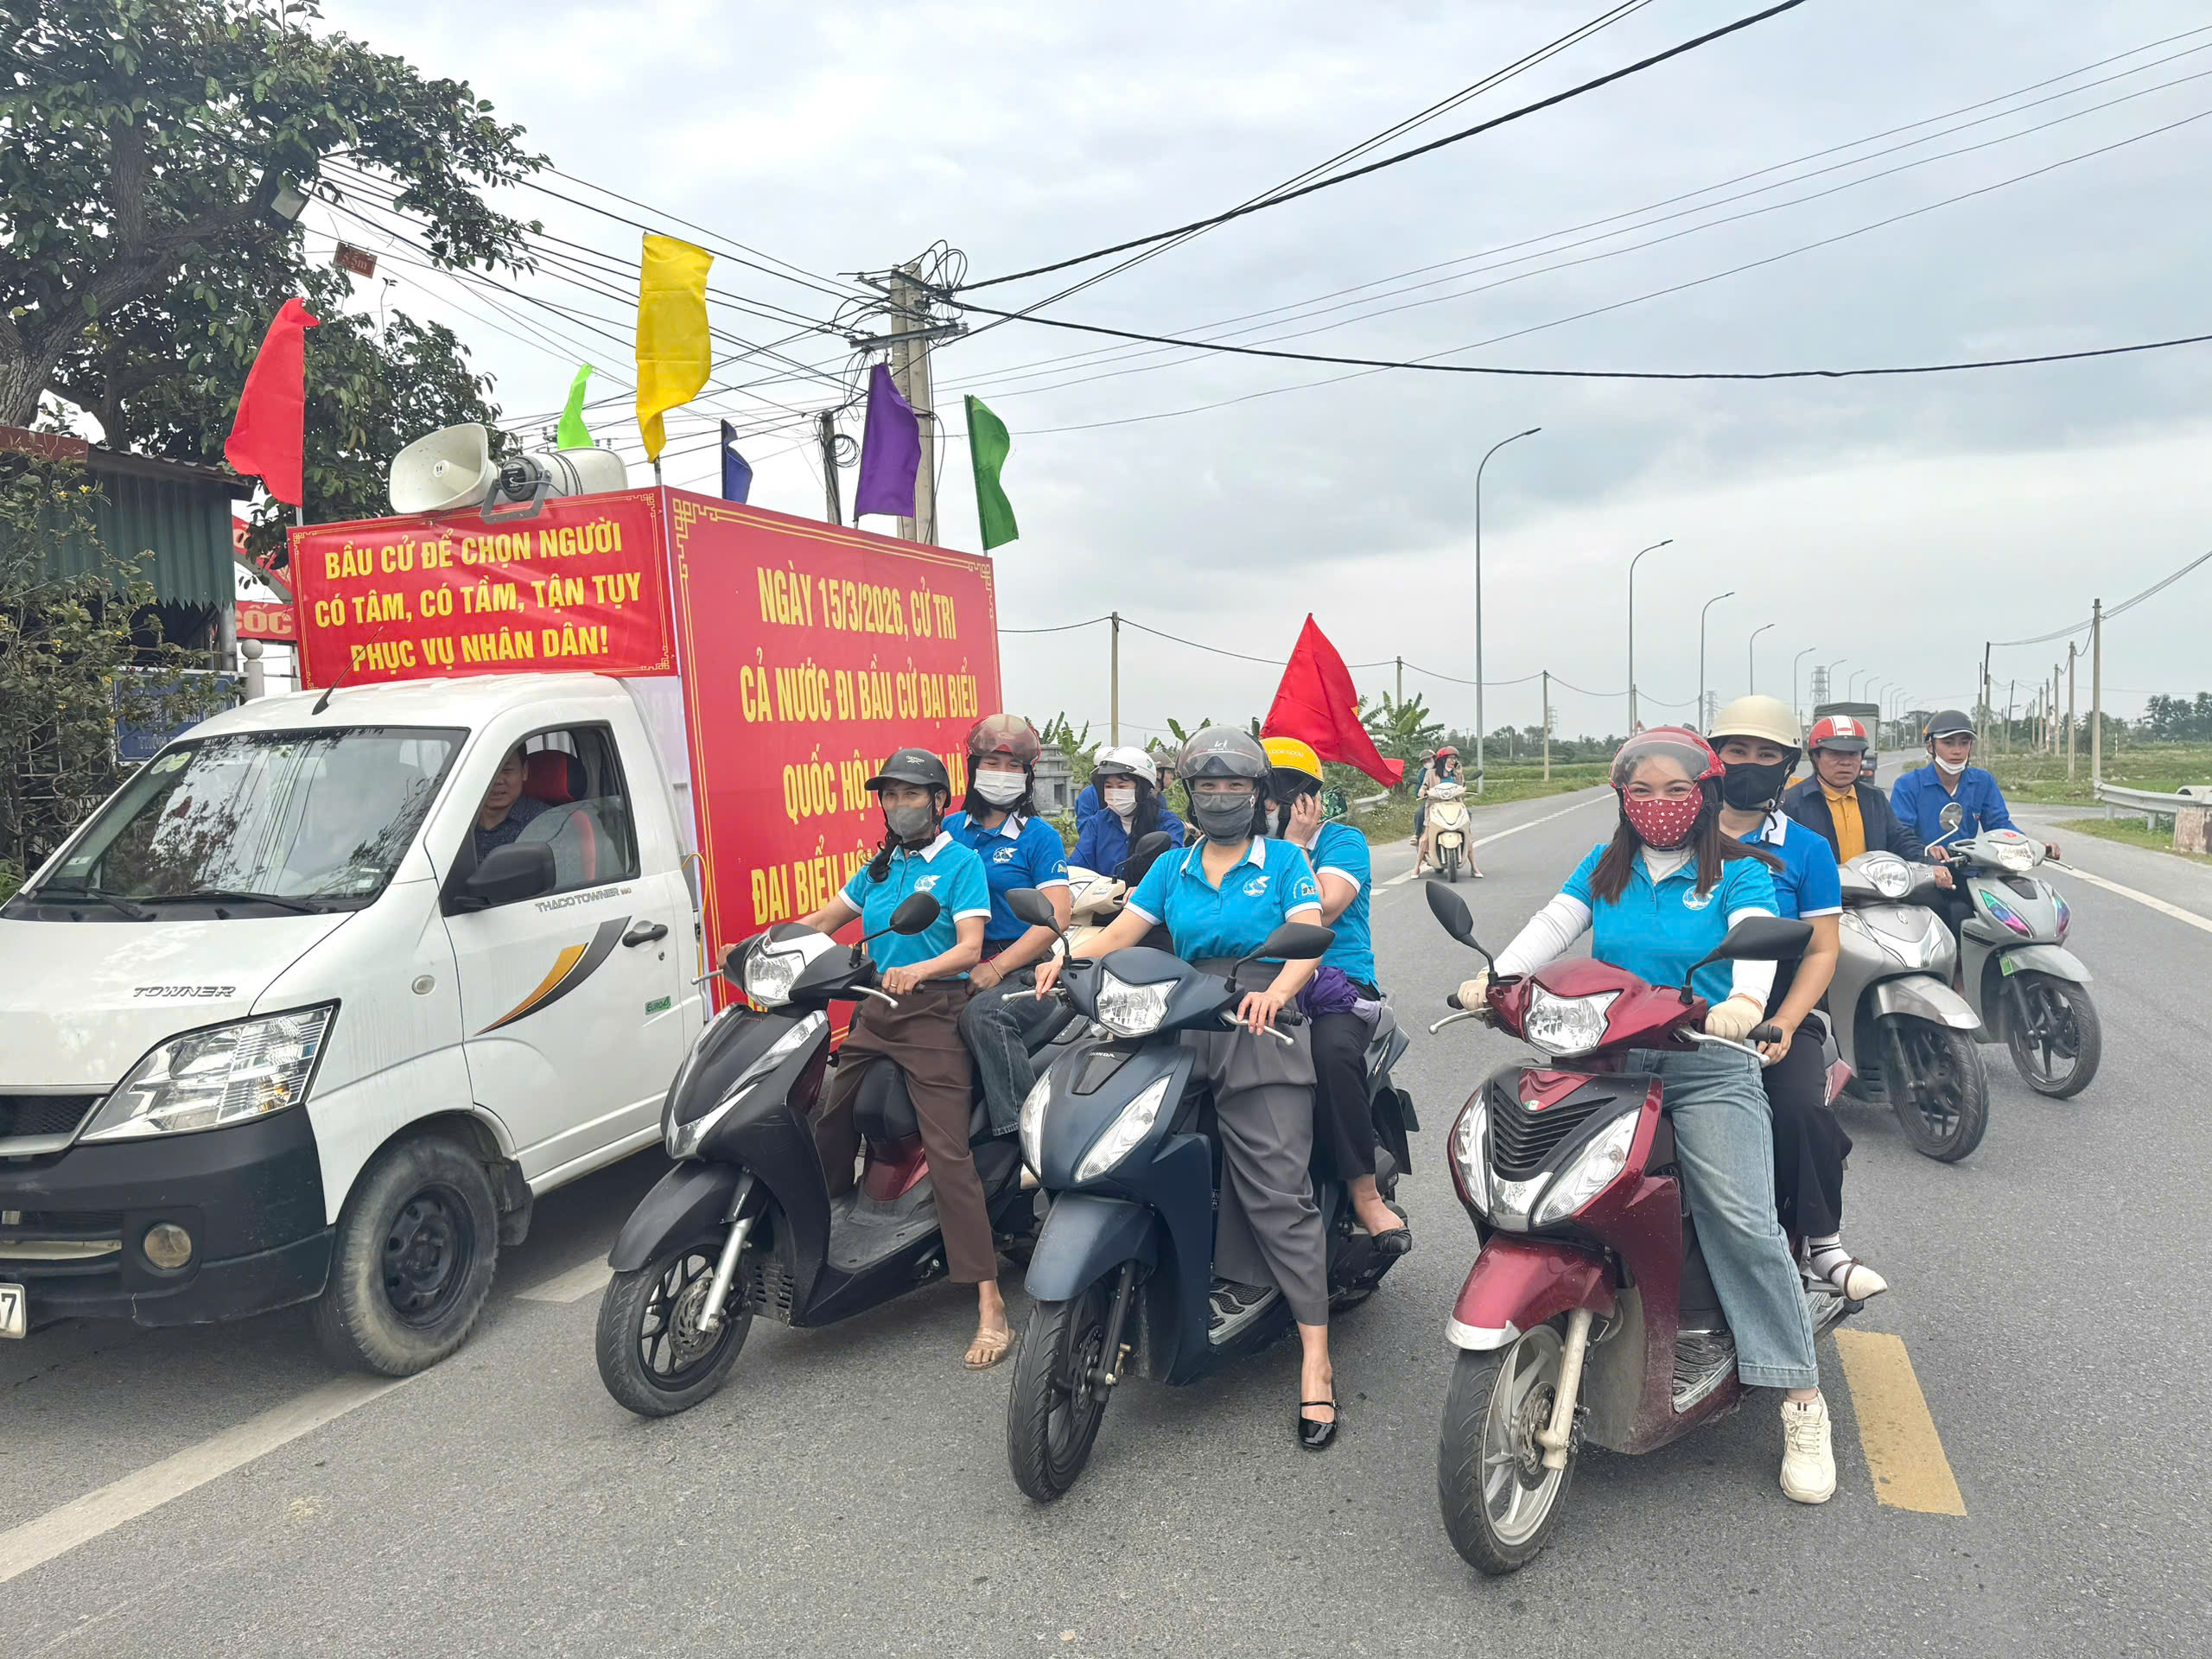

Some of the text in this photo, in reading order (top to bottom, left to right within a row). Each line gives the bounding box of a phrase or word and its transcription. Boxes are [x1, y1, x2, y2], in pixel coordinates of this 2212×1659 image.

[325, 518, 622, 580] BẦU CỬ ĐỂ CHỌN NGƯỜI
[315, 573, 642, 628] CÓ TÂM, CÓ TẦM, TẬN TỤY
[756, 559, 957, 642] NGÀY 15/3/2026, CỬ TRI
[349, 621, 609, 678] PHỤC VỤ NHÂN DÂN!
[739, 646, 978, 728] CẢ NƯỚC ĐI BẦU CỬ ĐẠI BIỂU
[783, 743, 837, 824] QUỐC
[840, 749, 873, 821] HỘI
[793, 835, 840, 915] BIỂU
[133, 986, 236, 997] TOWNER
